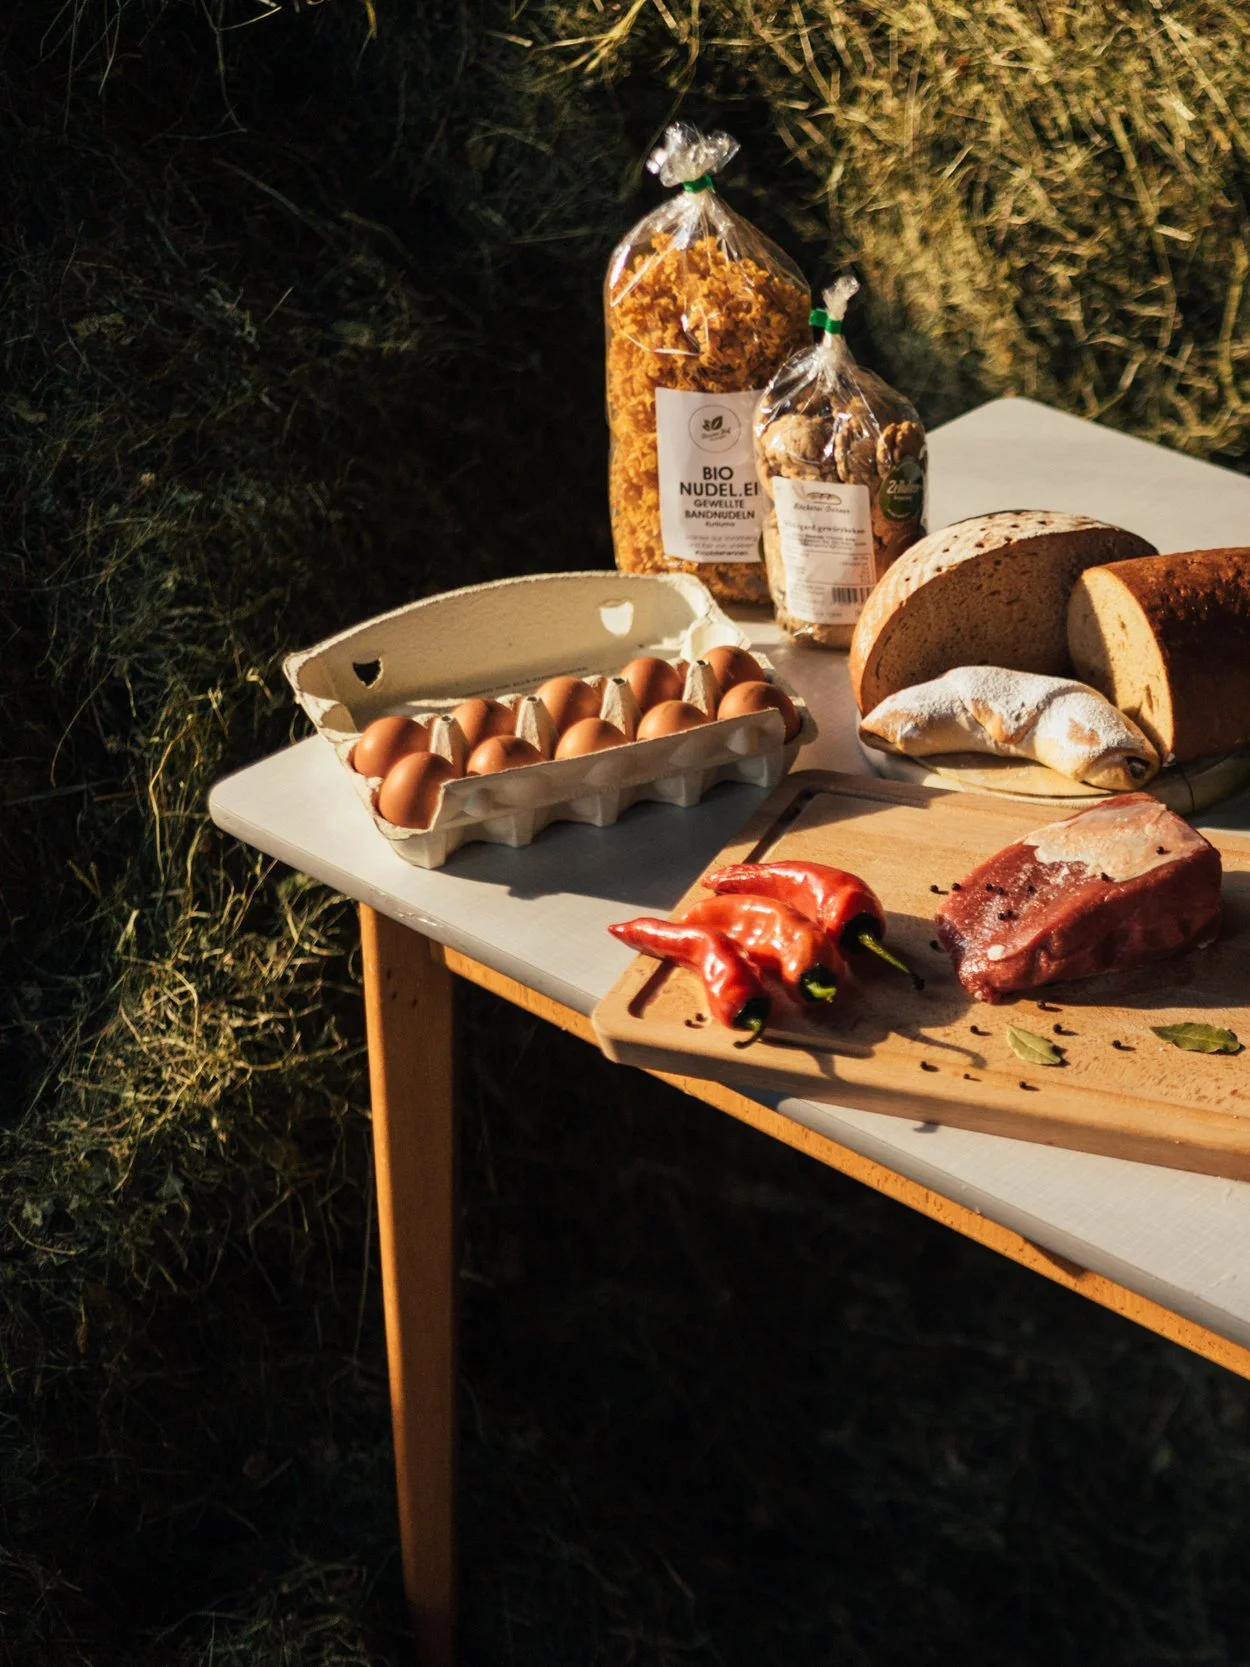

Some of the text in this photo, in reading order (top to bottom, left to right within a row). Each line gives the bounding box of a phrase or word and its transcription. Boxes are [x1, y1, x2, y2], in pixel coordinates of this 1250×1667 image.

[703, 466, 734, 481] BIO
[680, 482, 758, 497] NUDEL.EI
[693, 499, 745, 509] GEWELLTE
[684, 509, 755, 520] BANDNUDELN
